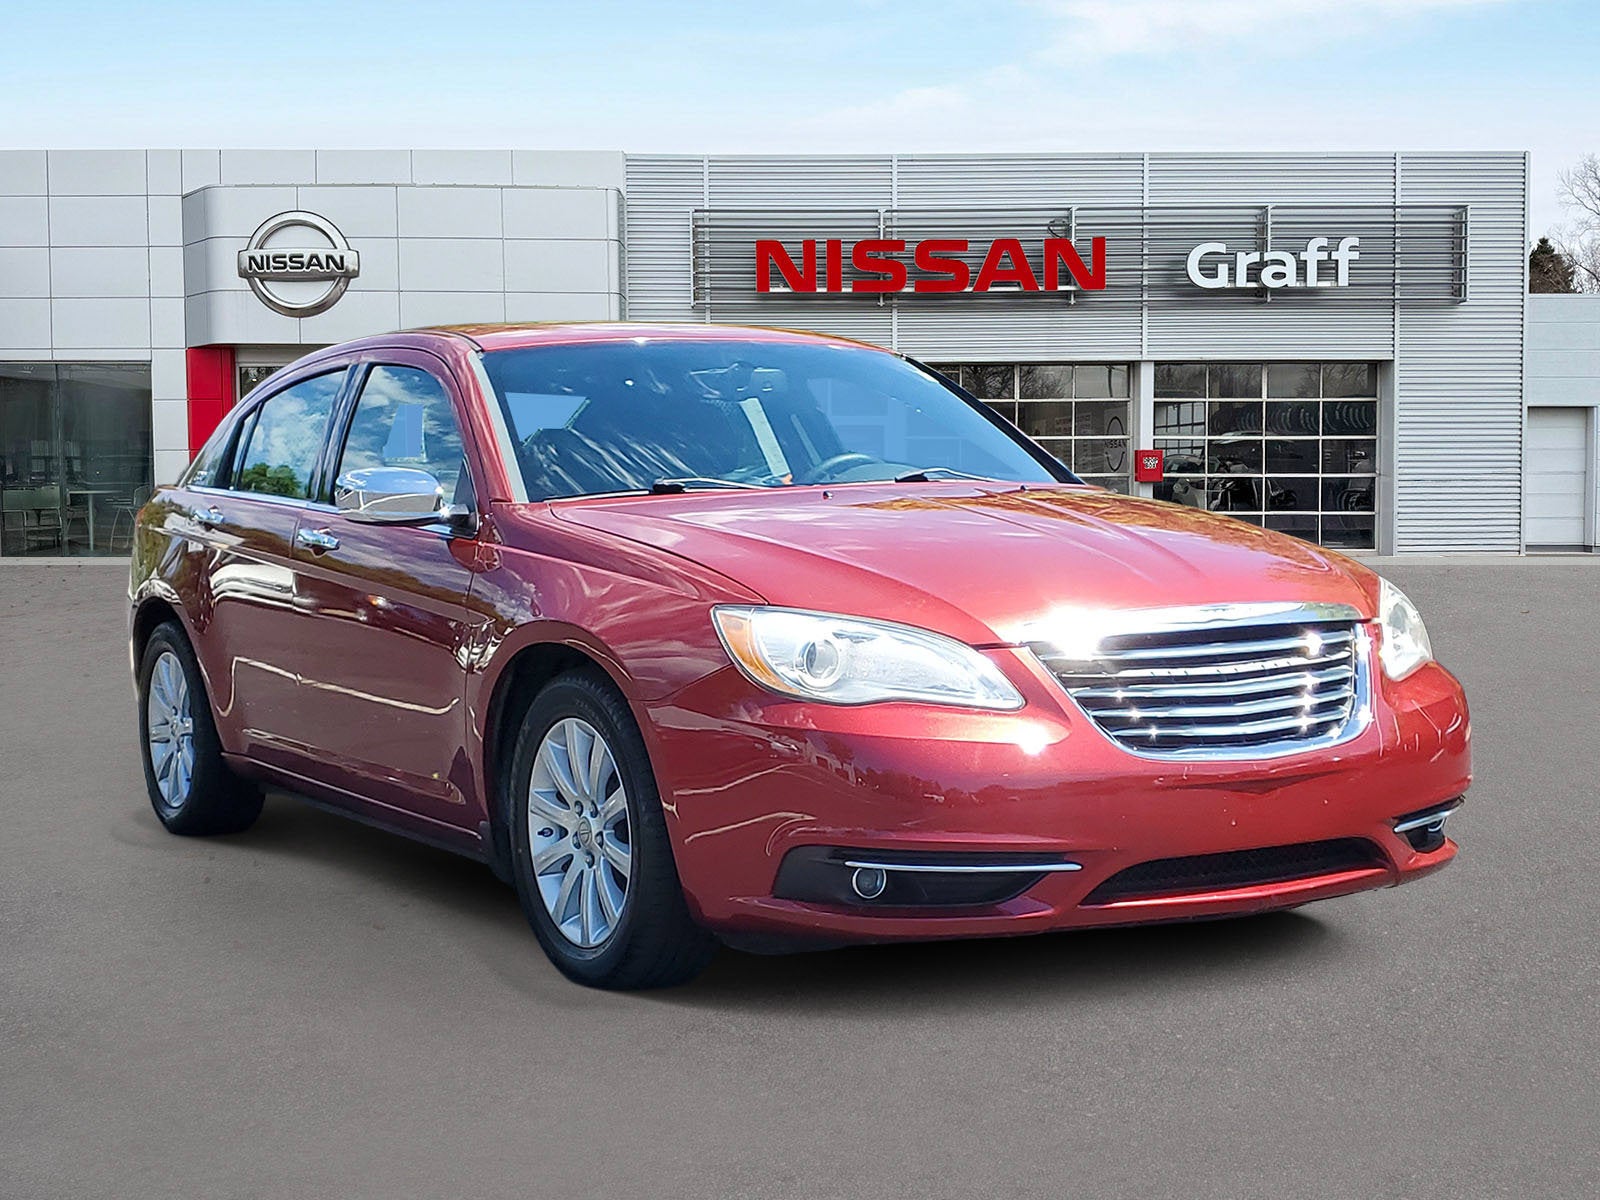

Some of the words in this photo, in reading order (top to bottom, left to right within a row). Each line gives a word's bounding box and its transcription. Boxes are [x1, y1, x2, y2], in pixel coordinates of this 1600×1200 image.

[248, 254, 345, 272] NISSAN
[756, 236, 1106, 292] NISSAN
[1186, 237, 1360, 289] Graff
